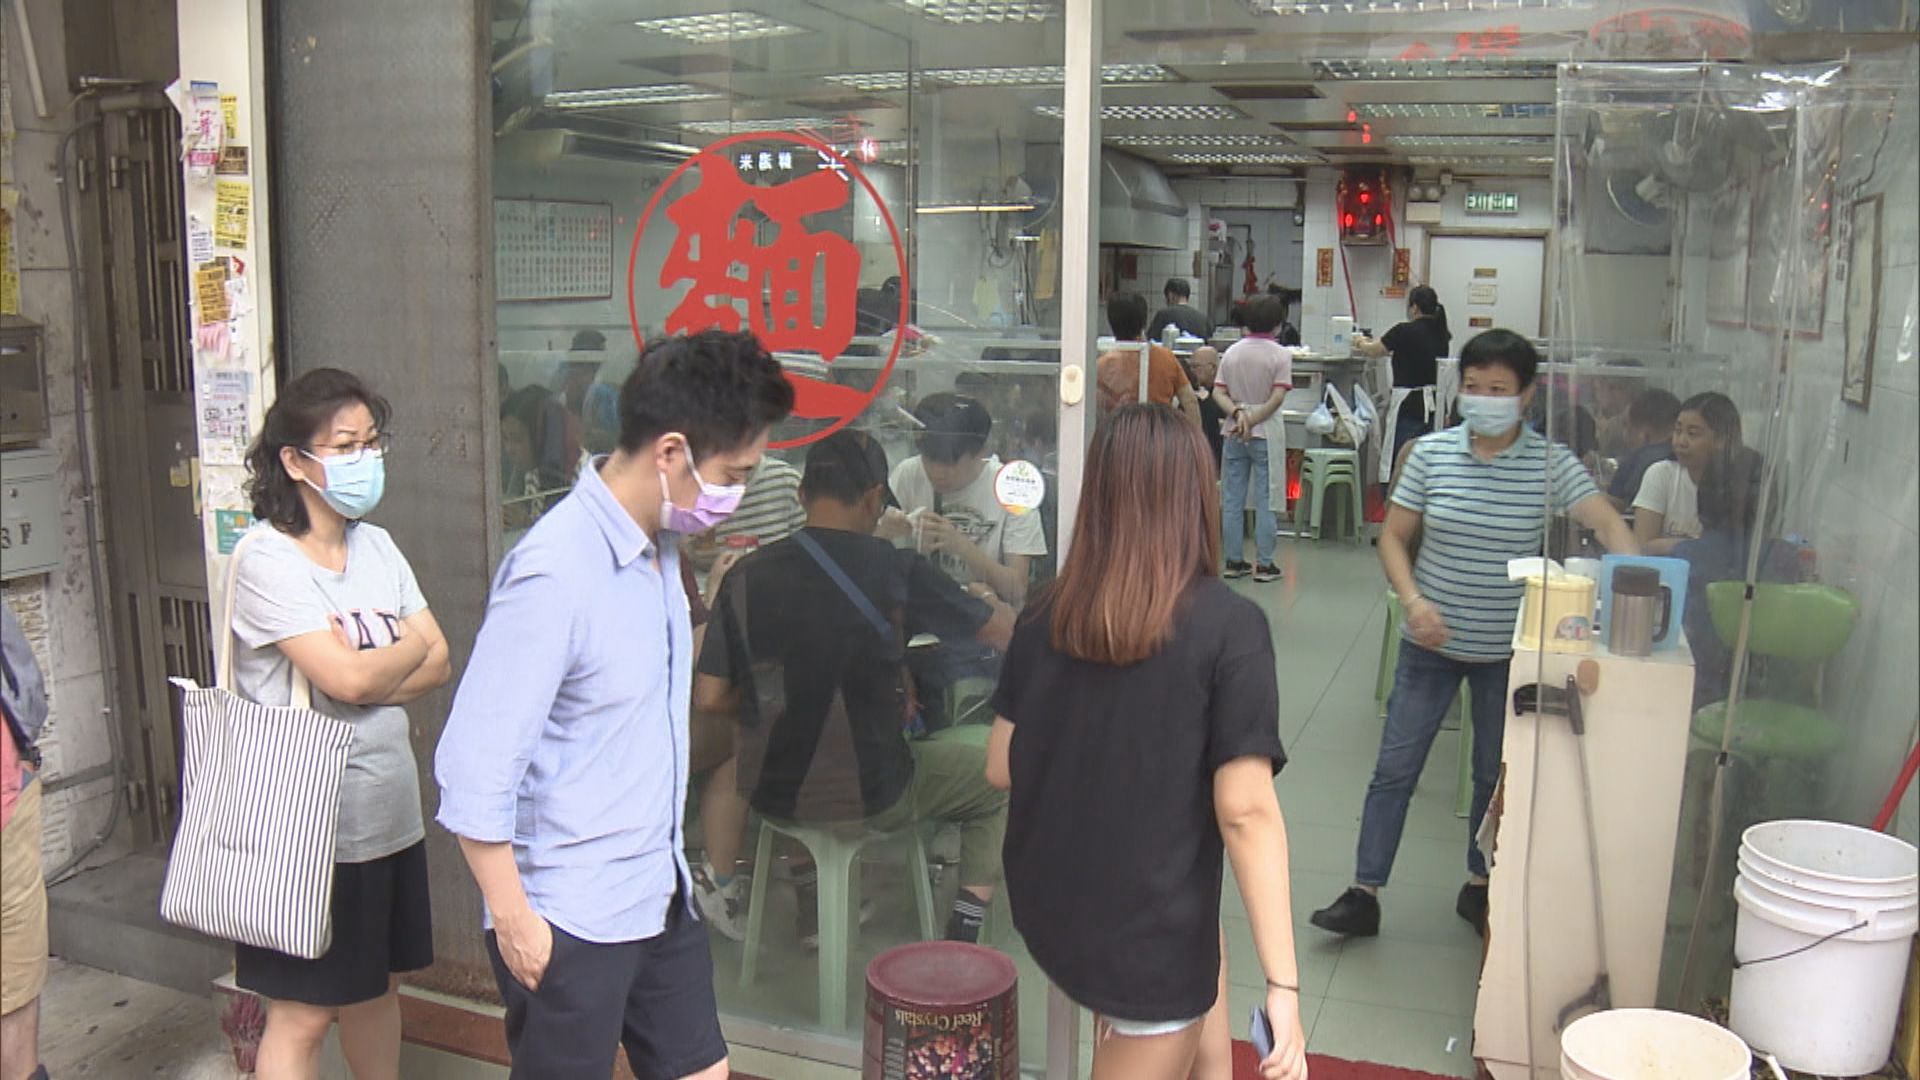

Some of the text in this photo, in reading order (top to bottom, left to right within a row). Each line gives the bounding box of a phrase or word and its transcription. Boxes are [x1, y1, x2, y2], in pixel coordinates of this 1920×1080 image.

[1467, 192, 1515, 209] EXIT 出口
[335, 611, 401, 651] AP
[895, 1009, 983, 1031] Reef Crystals
